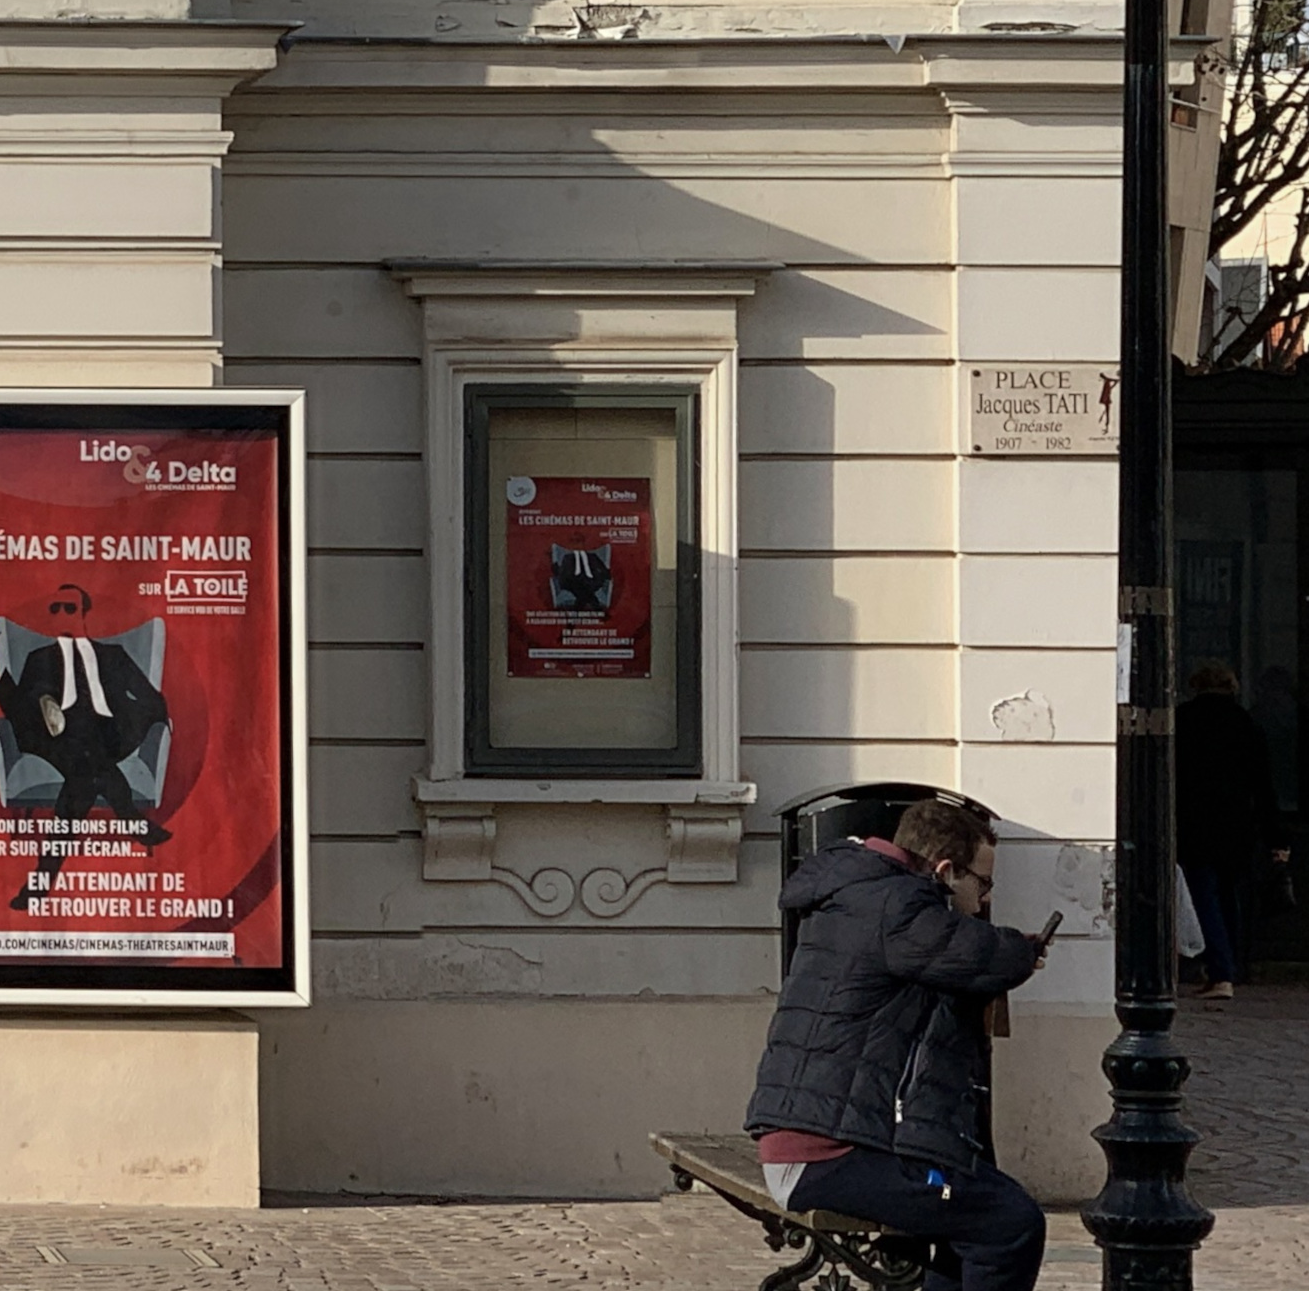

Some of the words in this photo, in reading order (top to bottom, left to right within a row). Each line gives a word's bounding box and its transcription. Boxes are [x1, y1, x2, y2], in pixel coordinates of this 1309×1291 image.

[995, 371, 1071, 390] PLACE
[976, 393, 1040, 418] Jacques
[1044, 393, 1089, 414] TATI
[1003, 419, 1063, 433] Cinéaste
[80, 440, 131, 461] Lido
[995, 437, 1022, 450] 1907
[1045, 437, 1072, 450] 1982
[145, 461, 162, 482] 4
[168, 460, 236, 482] Delta
[519, 516, 534, 525] LES
[535, 514, 573, 525] CINÉMAS
[574, 516, 585, 525] DE
[586, 516, 639, 526] SAINT-MAUR
[66, 535, 95, 560] DE
[101, 535, 252, 561] SAINT-MAUR
[138, 582, 162, 595] SUR
[164, 578, 189, 595] LA
[193, 578, 248, 595] TOILE
[18, 819, 36, 834] DE
[37, 817, 70, 834] TRÈS
[72, 820, 107, 834] BONS
[110, 820, 148, 835] FILMS
[10, 841, 39, 857] SUR
[42, 841, 81, 857] PETIT
[84, 838, 146, 857] ÉCRAN...
[27, 872, 50, 891] EN
[55, 872, 158, 892] ATTENDANT
[162, 873, 185, 892] DE
[27, 897, 132, 917] RETROUVER
[136, 898, 156, 917] LE
[160, 898, 223, 918] GRAND
[227, 899, 234, 918] !
